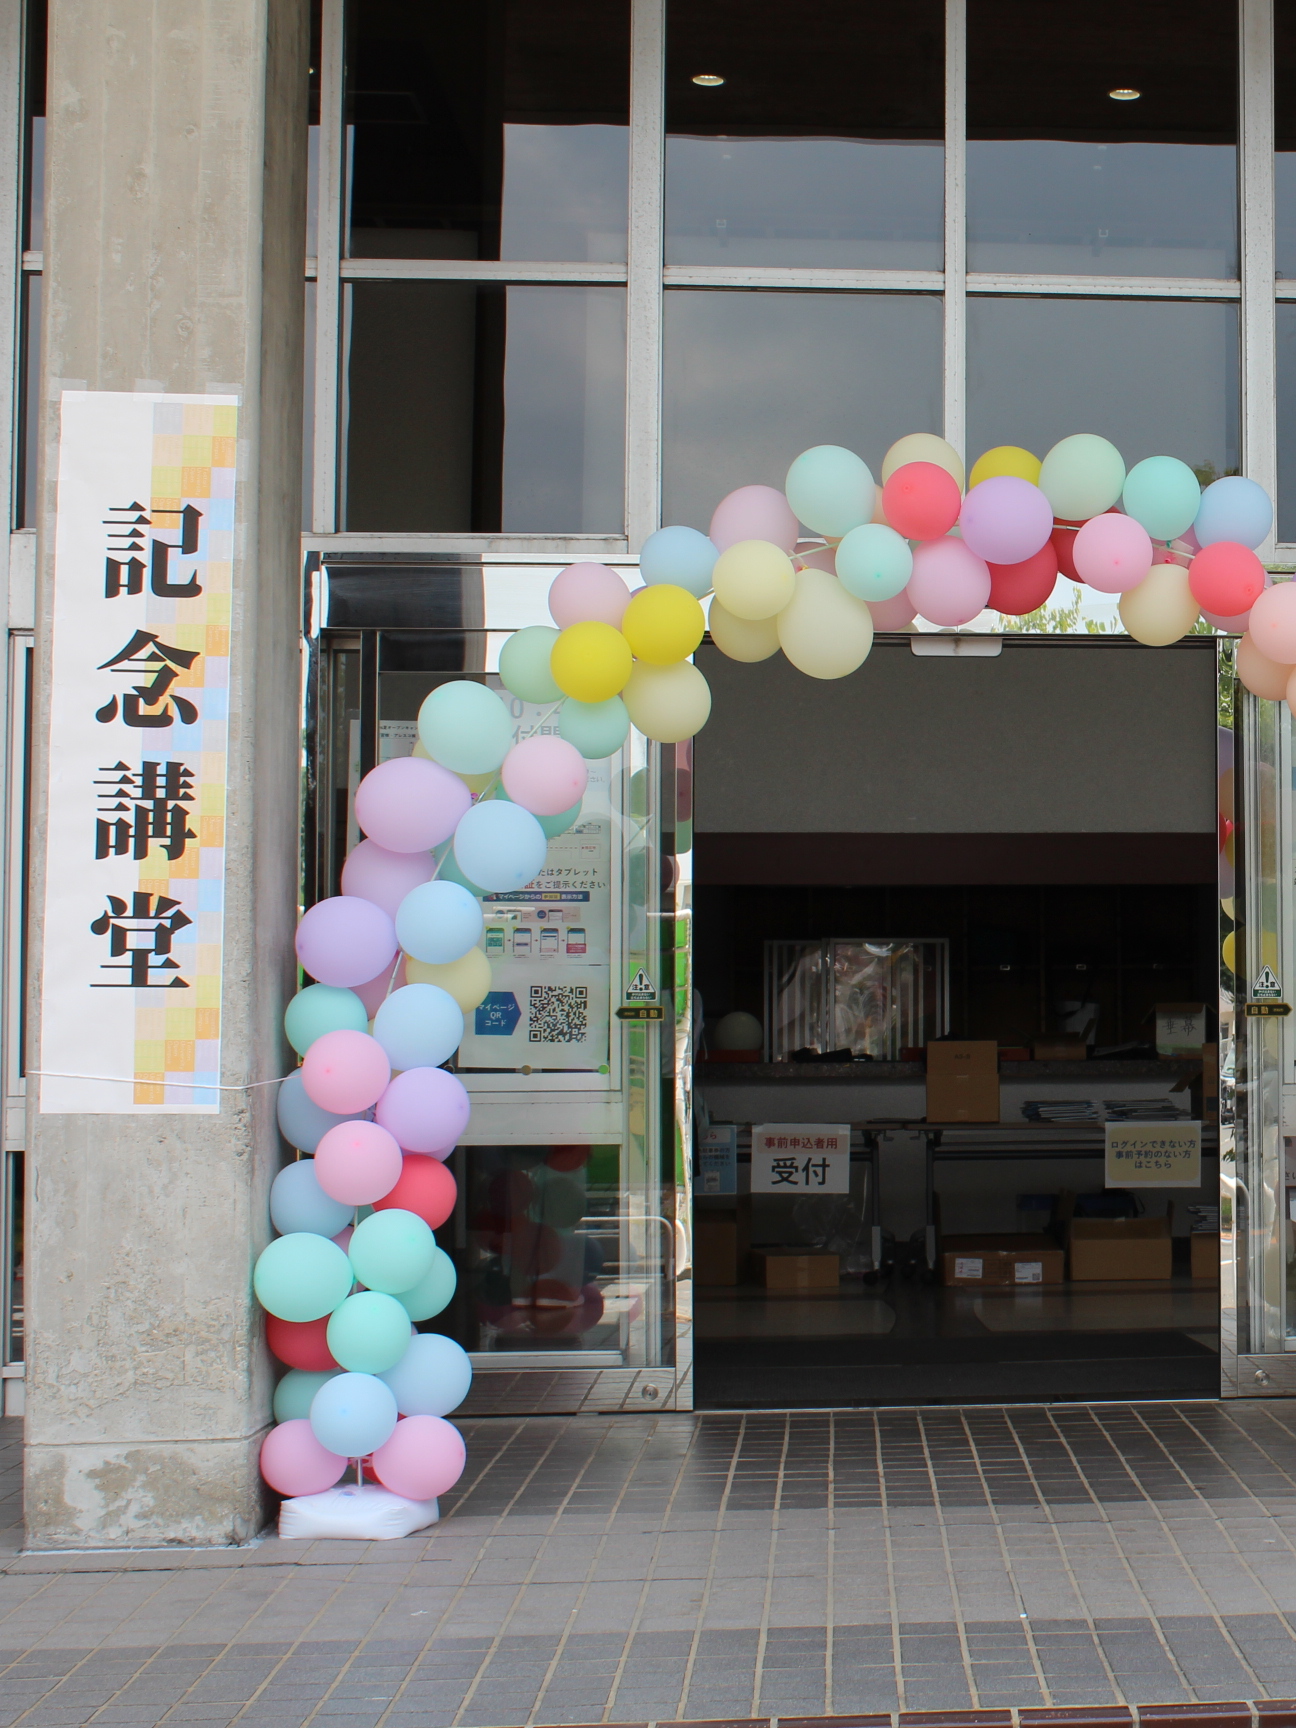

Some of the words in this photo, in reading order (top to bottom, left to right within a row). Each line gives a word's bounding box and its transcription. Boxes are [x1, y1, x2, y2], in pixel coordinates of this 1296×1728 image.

[89, 502, 203, 988] 記念講堂
[477, 1003, 515, 1012] マイページ
[490, 1012, 502, 1020] QR
[764, 1136, 838, 1151] 事前申込者用
[1111, 1140, 1196, 1149] ログインできない方
[1115, 1150, 1191, 1159] 事前予約のない方
[1135, 1160, 1172, 1169] はこちら
[771, 1157, 830, 1187] 受付
